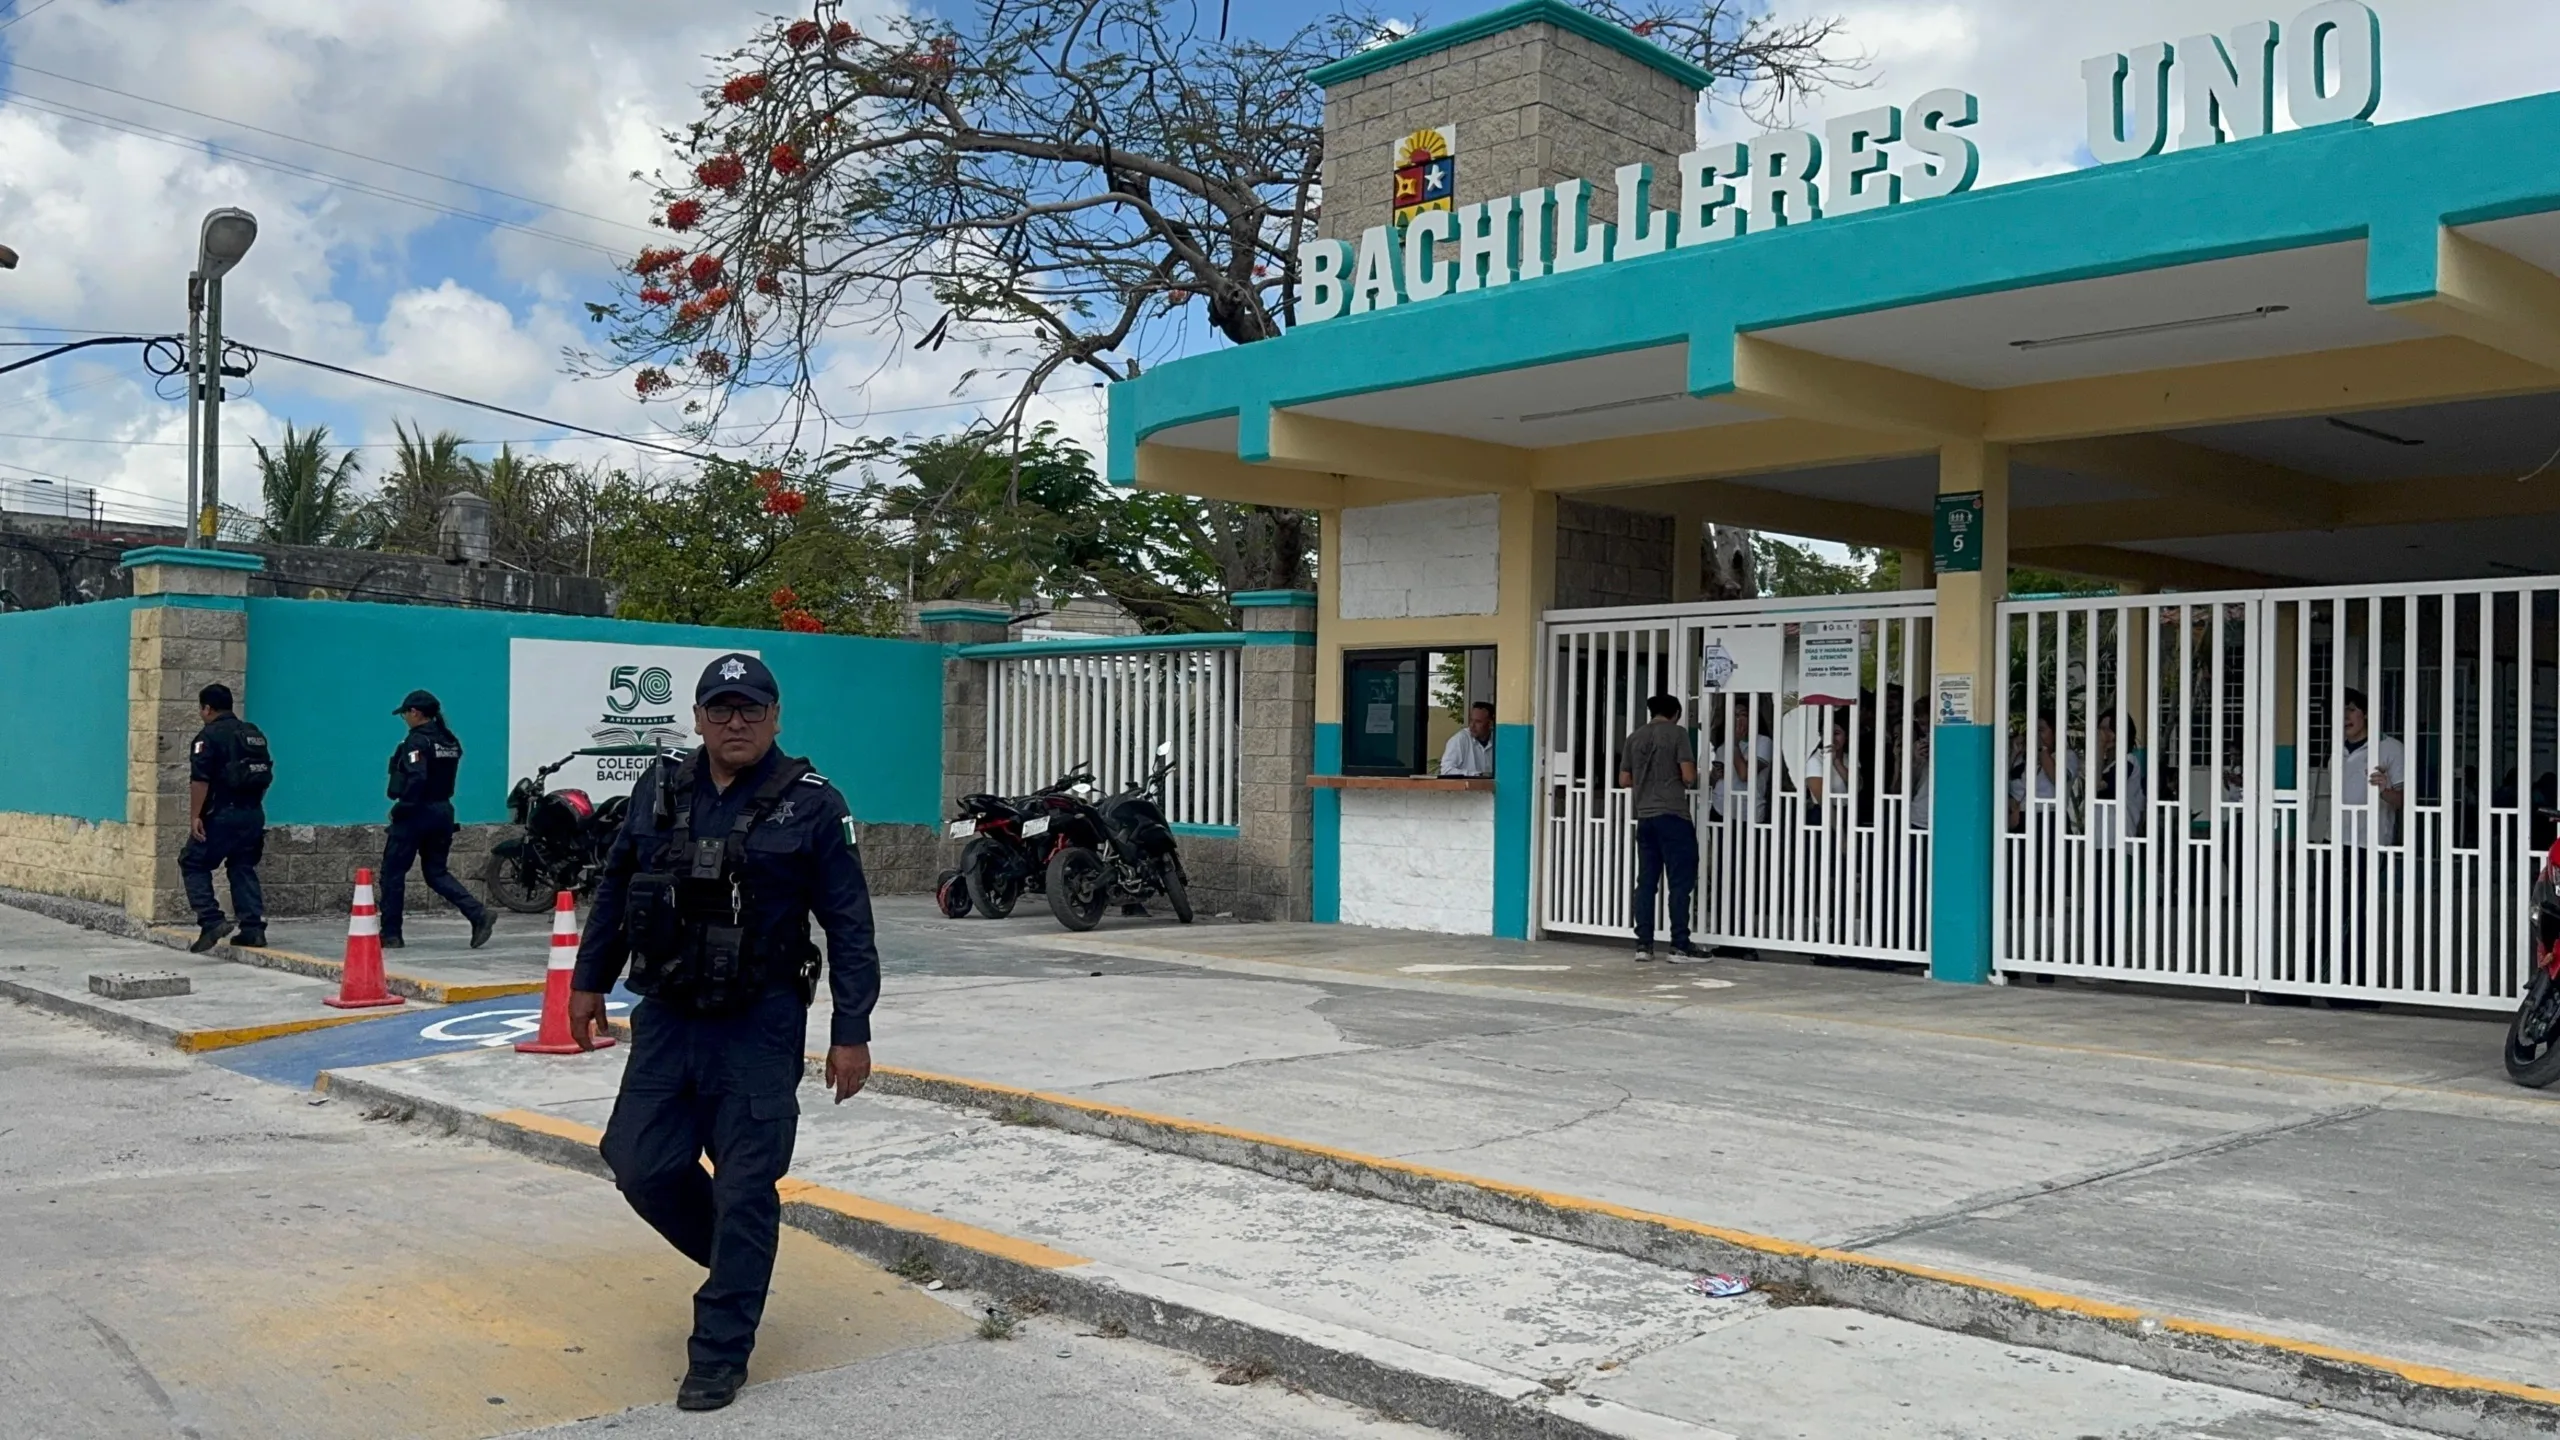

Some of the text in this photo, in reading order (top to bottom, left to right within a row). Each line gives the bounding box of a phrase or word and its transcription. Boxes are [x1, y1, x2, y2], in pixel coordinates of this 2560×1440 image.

[1296, 0, 2382, 326] BACHILLERES UNO
[606, 665, 673, 714] 50
